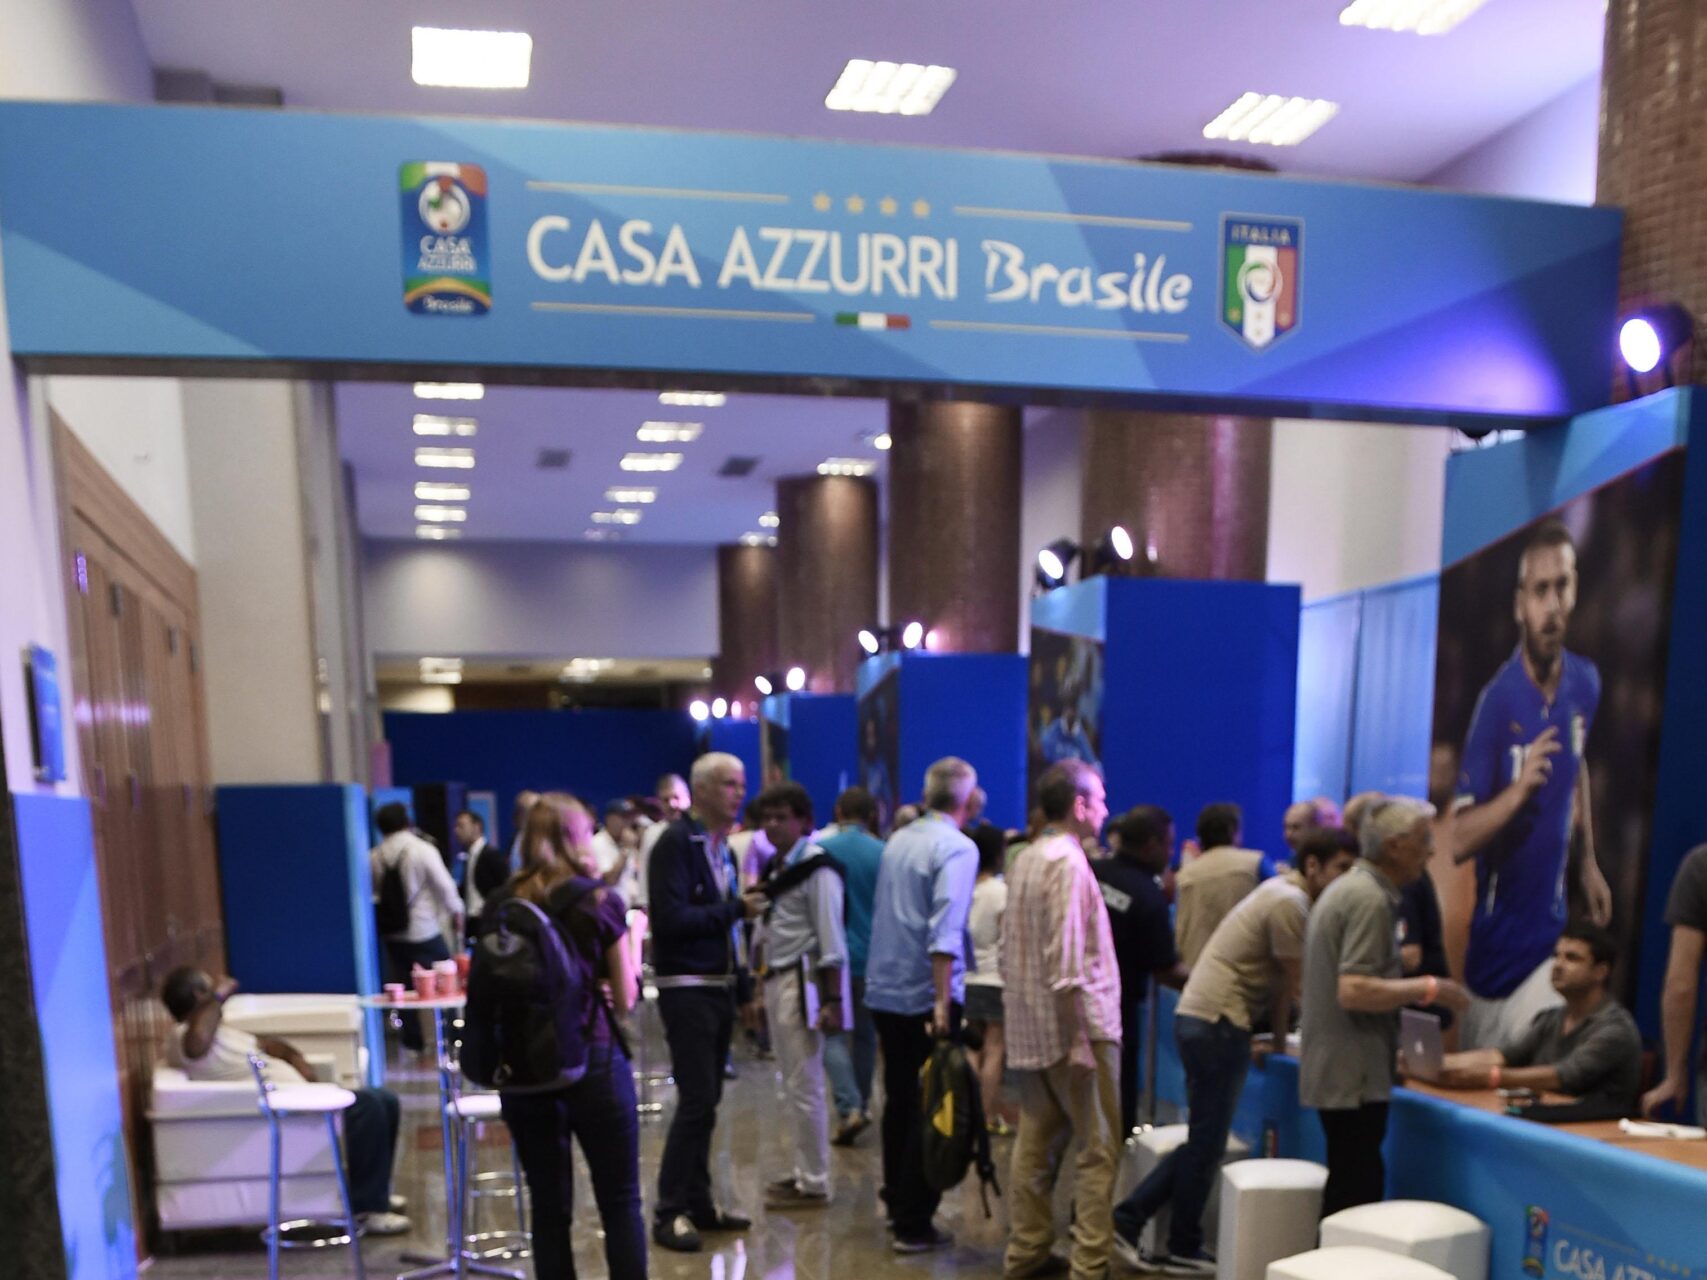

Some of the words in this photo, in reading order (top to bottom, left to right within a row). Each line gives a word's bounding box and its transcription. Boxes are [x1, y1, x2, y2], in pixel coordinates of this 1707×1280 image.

[420, 235, 472, 255] CASA
[1231, 223, 1291, 245] ITALIA
[527, 215, 701, 287] CASA
[718, 225, 959, 300] AZZURRI
[980, 238, 1194, 314] Brasile
